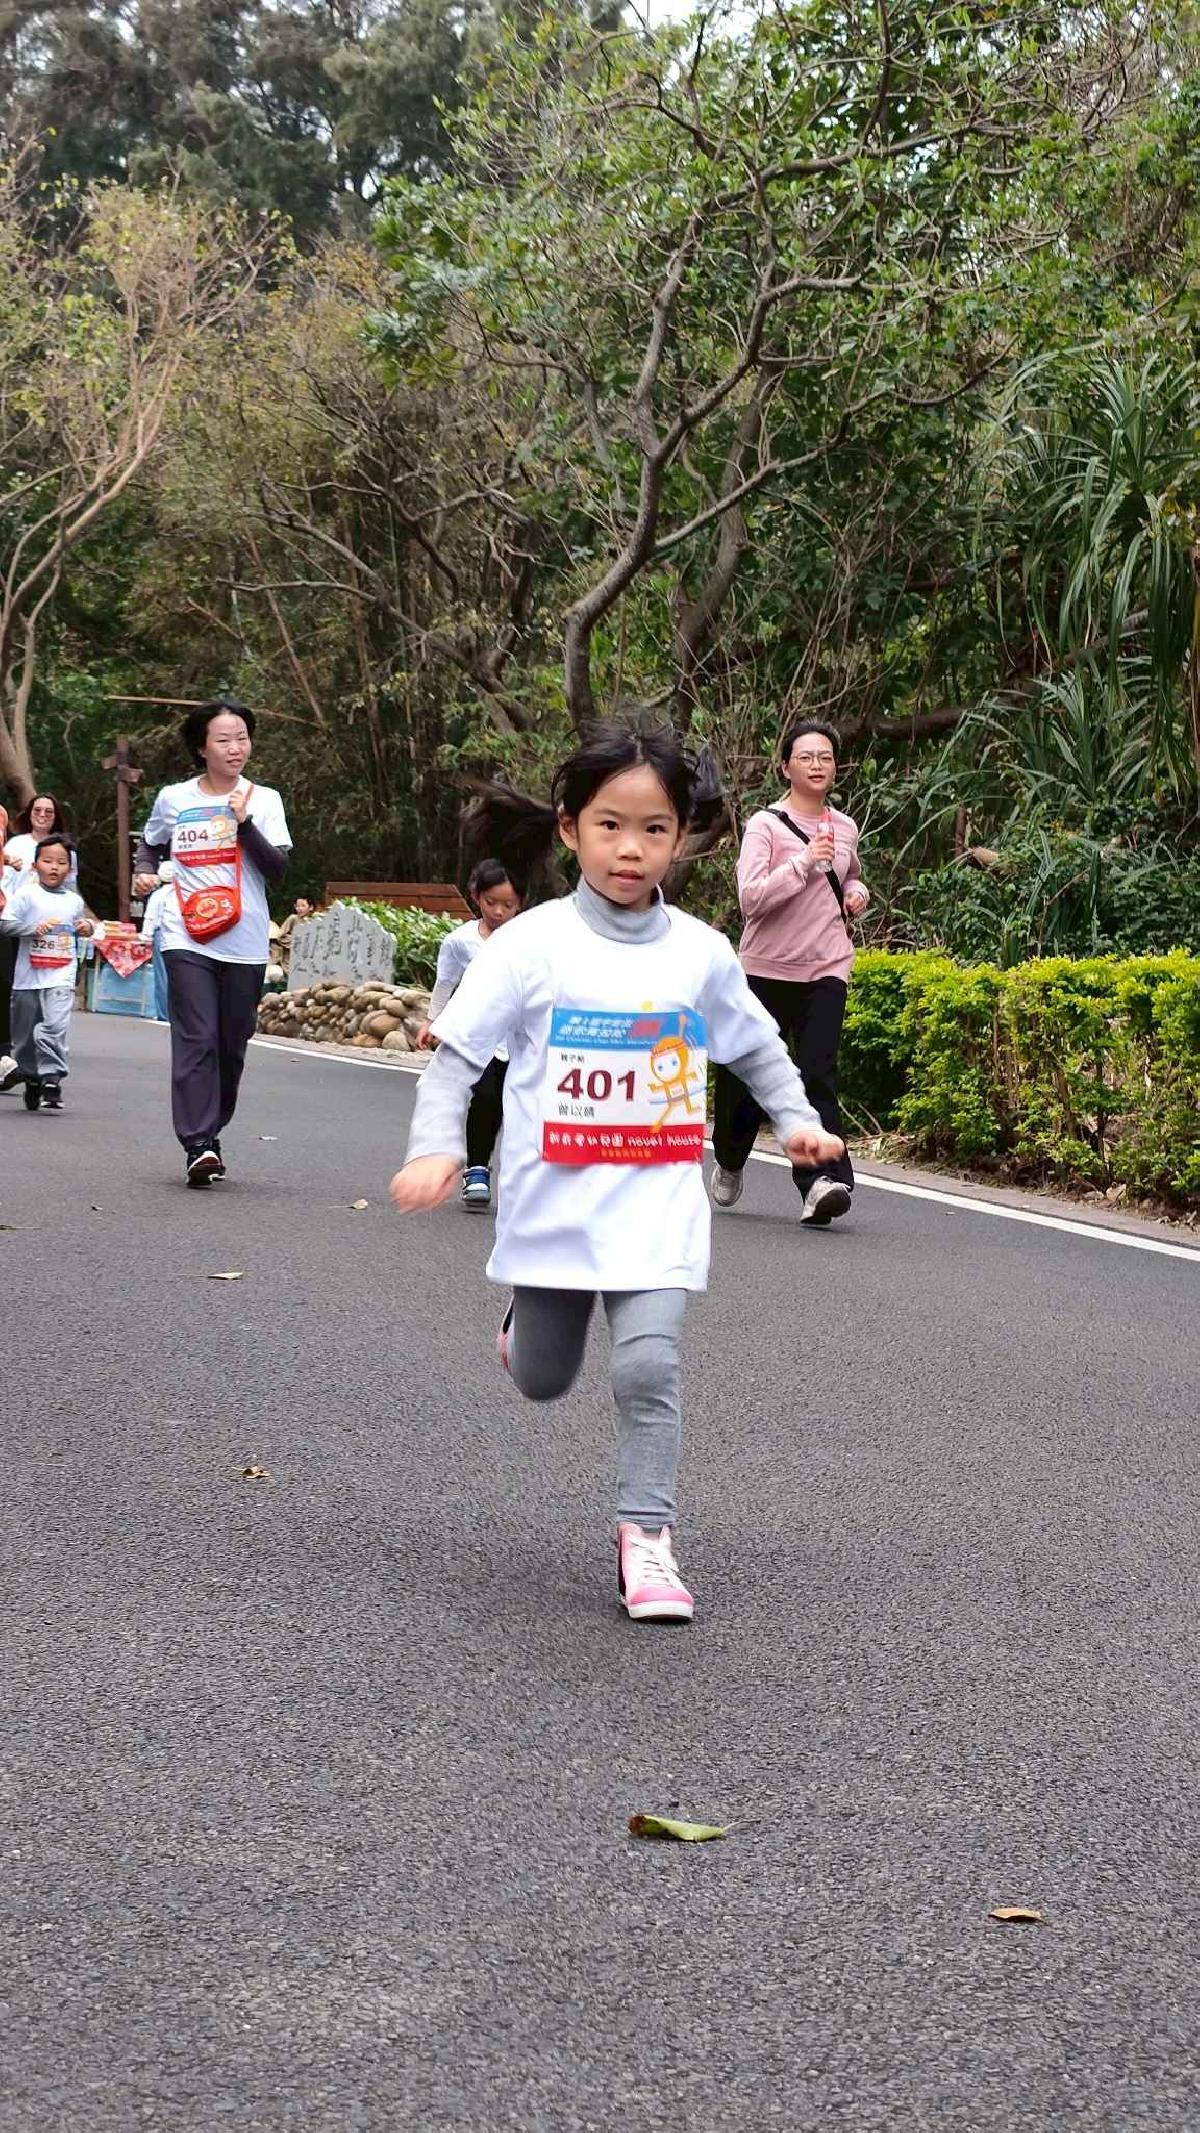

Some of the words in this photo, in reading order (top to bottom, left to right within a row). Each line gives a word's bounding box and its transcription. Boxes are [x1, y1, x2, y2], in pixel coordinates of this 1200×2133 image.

[177, 829, 209, 843] 404
[32, 939, 55, 950] 326
[557, 1068, 636, 1102] 401
